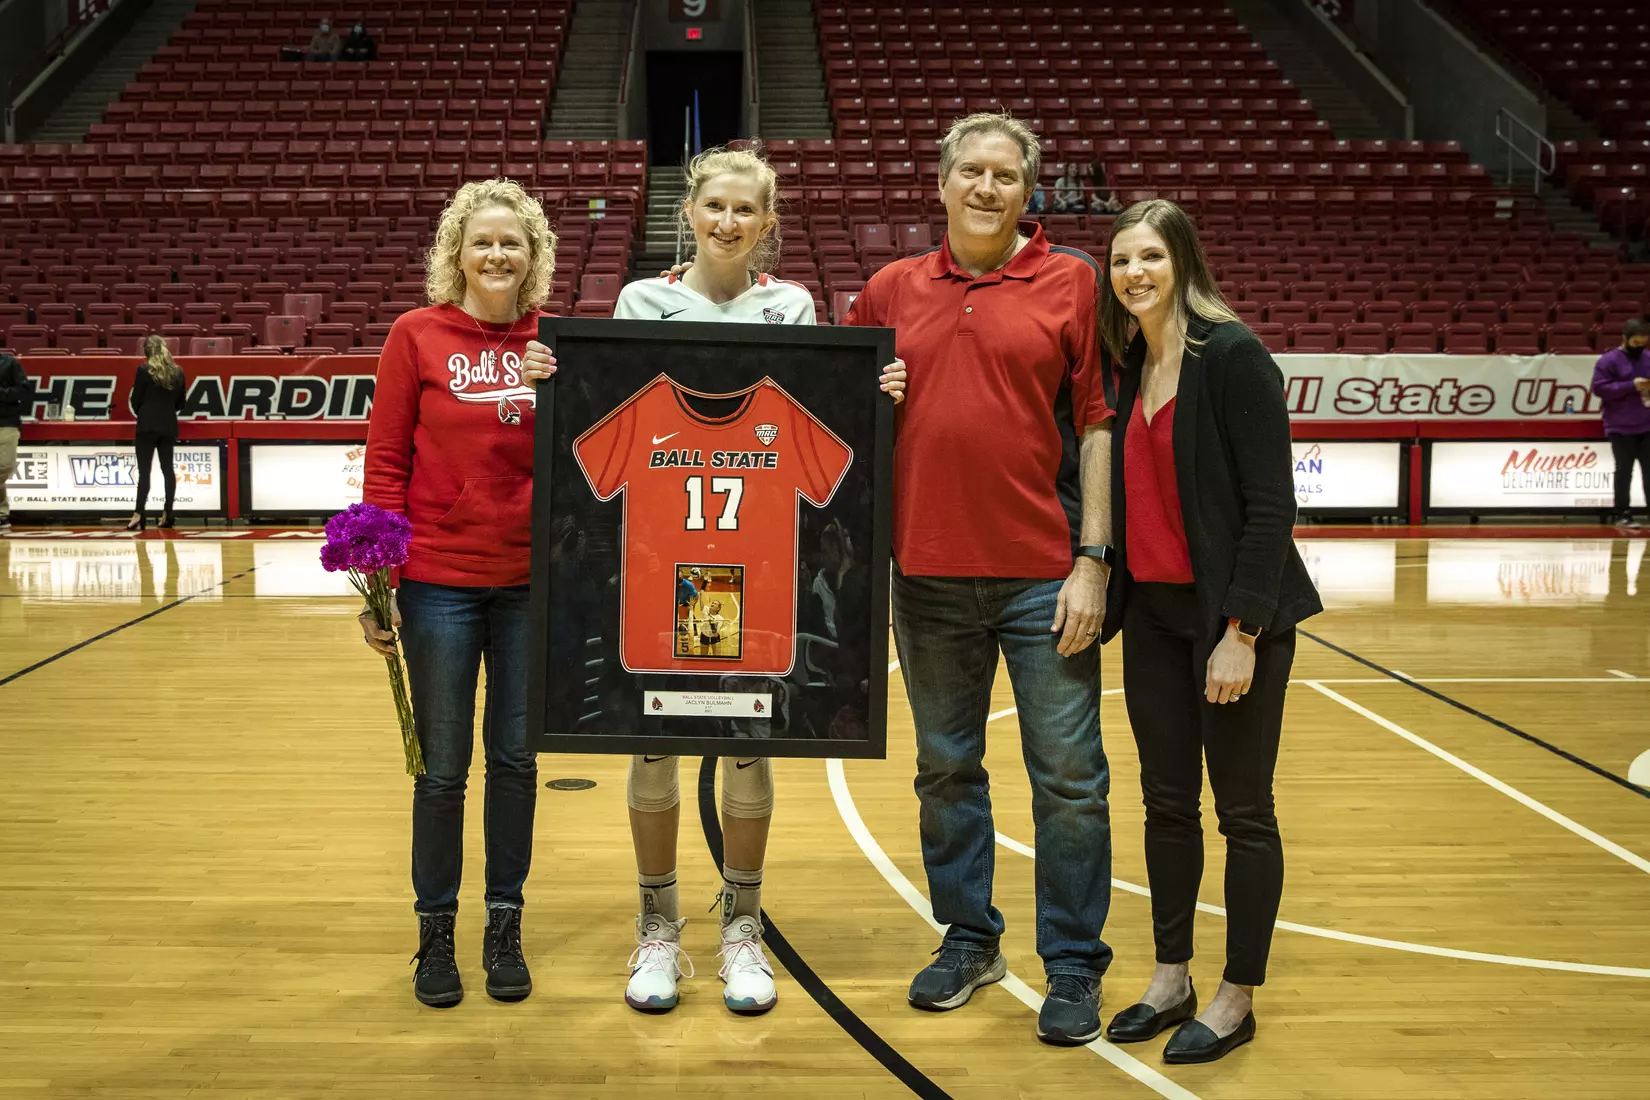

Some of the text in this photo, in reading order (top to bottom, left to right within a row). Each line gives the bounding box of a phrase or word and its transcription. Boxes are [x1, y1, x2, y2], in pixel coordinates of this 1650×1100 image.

[683, 0, 706, 17] 9
[447, 350, 523, 392] Ball S
[21, 375, 117, 420] HE
[1334, 376, 1495, 416] State
[173, 452, 212, 462] UNCIE
[649, 449, 778, 469] BALL STATE
[1501, 446, 1598, 476] Muncie
[72, 459, 135, 485] Werk
[1503, 471, 1570, 489] DELAWARE
[685, 475, 744, 531] 17
